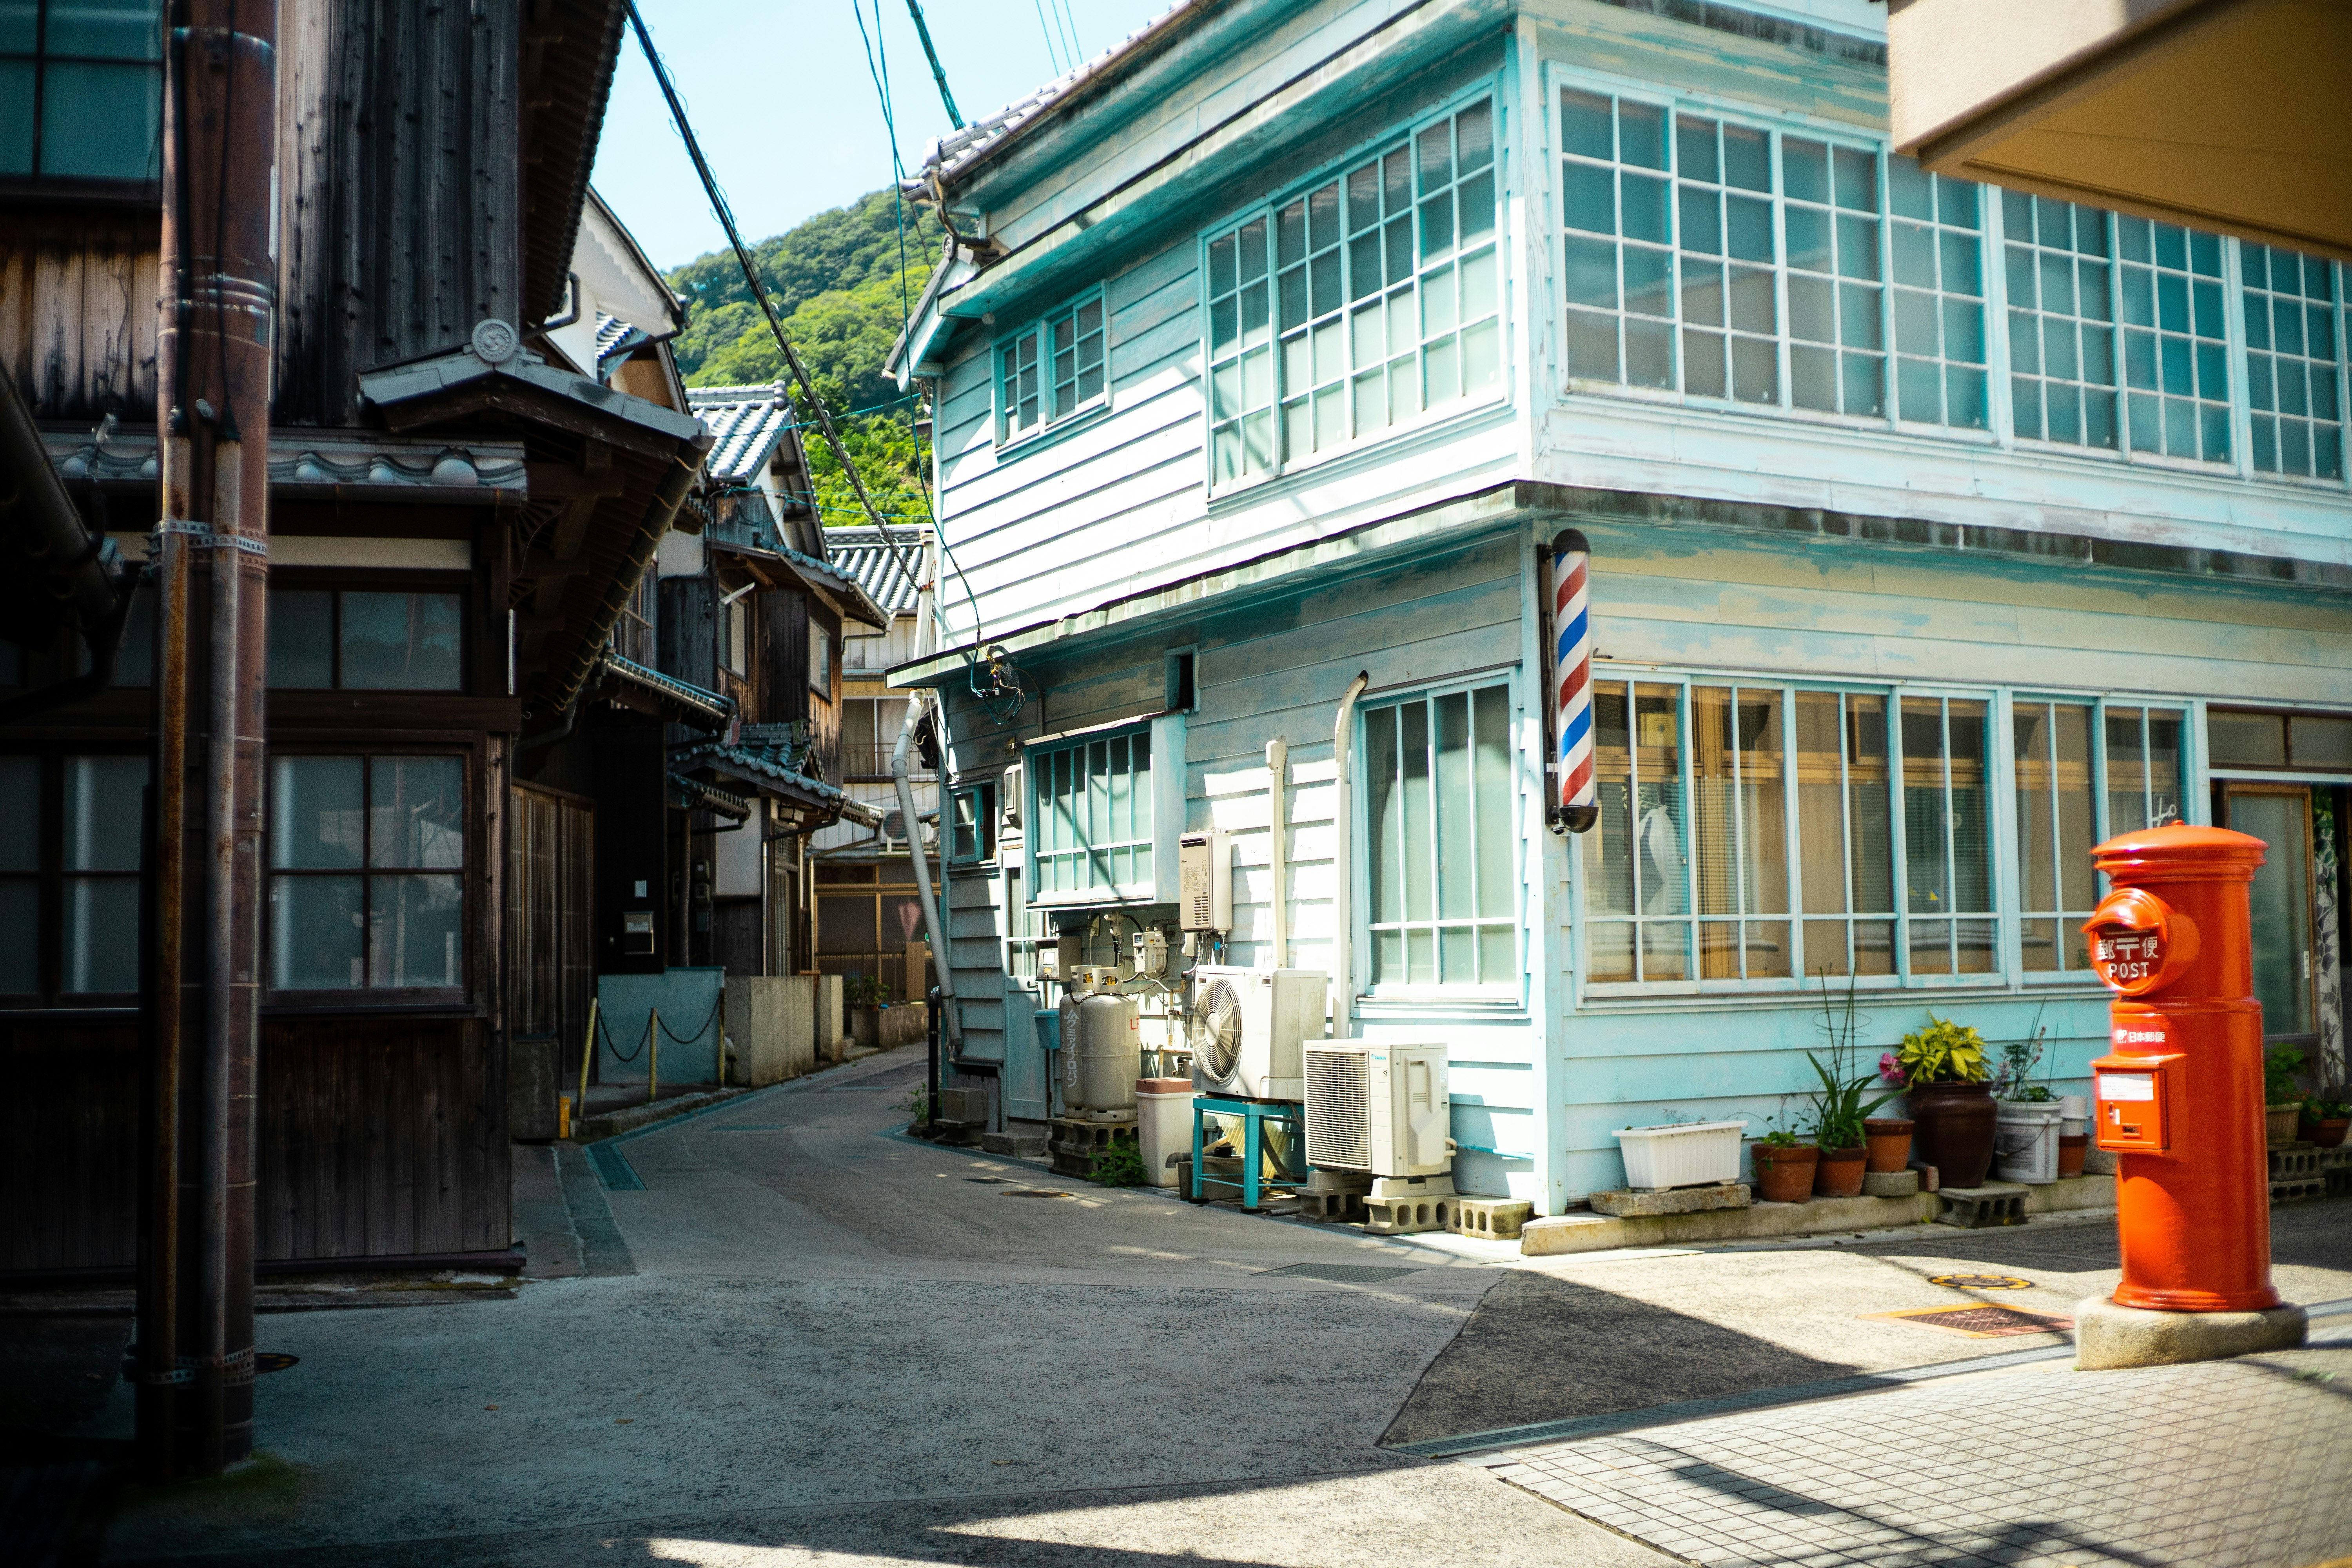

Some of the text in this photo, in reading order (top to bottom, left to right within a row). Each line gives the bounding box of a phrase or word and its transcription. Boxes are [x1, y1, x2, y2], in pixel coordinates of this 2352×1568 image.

[2109, 962, 2149, 978] POST
[2129, 1031, 2166, 1042] 日本郵便
